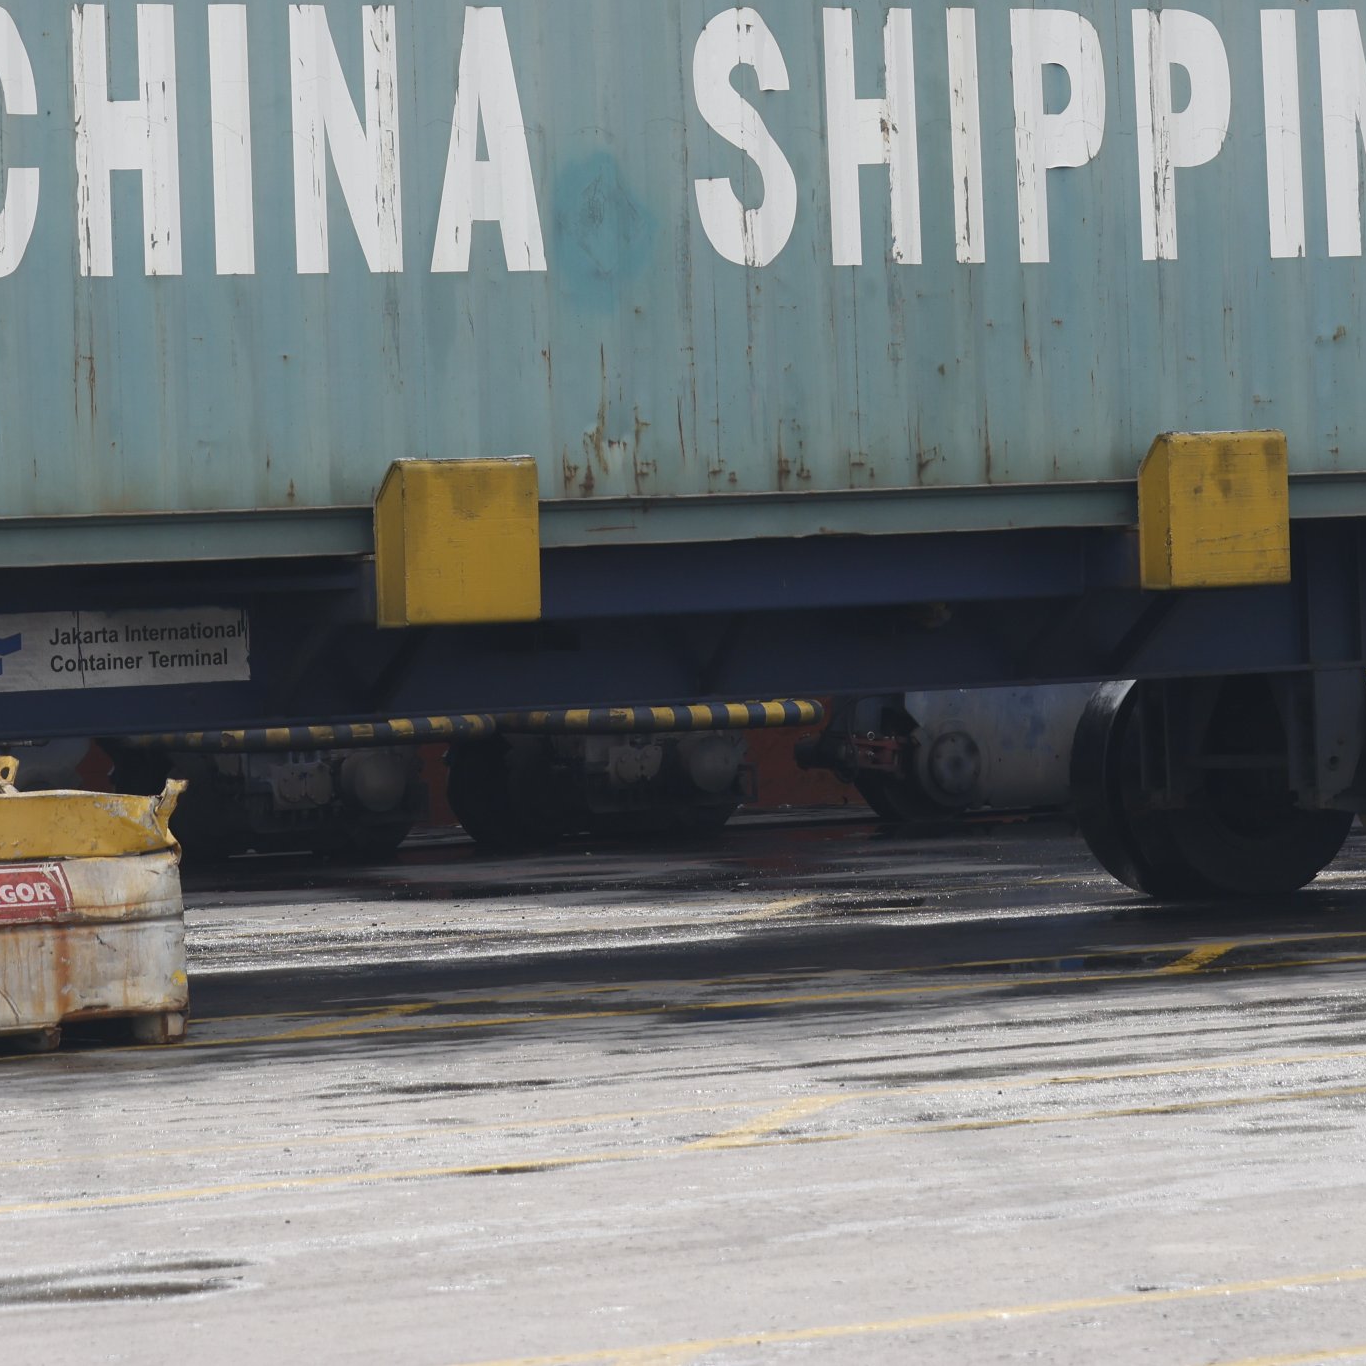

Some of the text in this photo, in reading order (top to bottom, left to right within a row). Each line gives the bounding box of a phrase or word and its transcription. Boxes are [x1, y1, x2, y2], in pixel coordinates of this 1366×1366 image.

[48, 620, 242, 646] Jakarta International
[49, 647, 229, 673] Container Terminal
